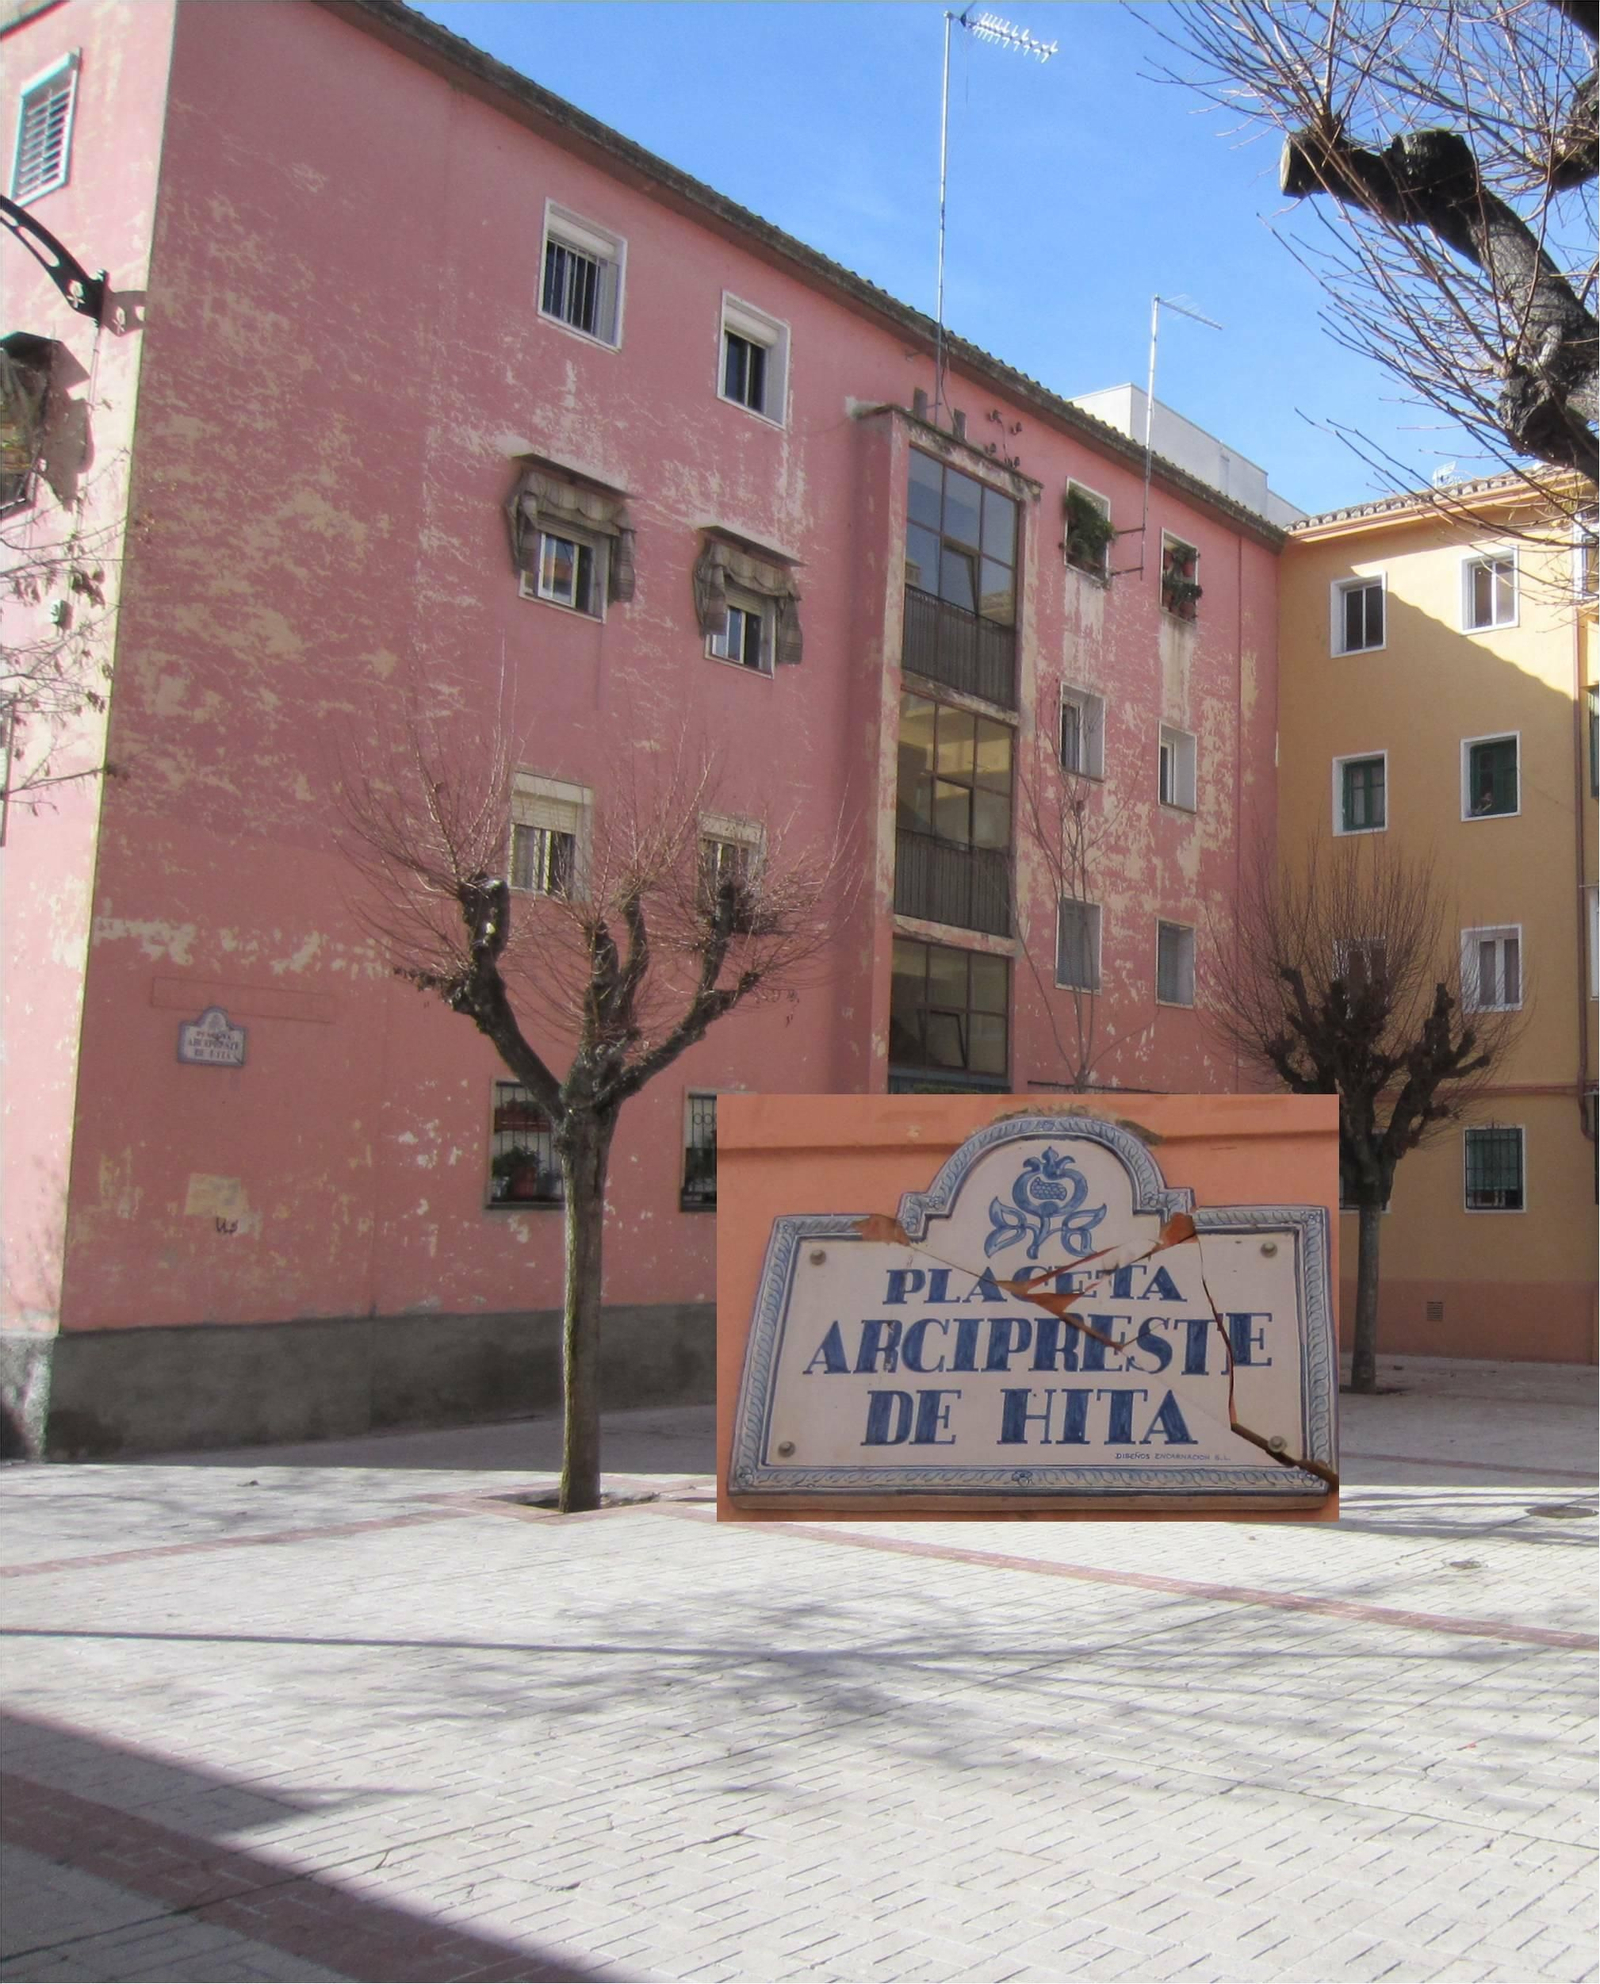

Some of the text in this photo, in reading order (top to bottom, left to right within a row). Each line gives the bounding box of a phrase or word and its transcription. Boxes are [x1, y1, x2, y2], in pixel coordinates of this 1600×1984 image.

[802, 1312, 1274, 1376] ARCIPRESTE
[860, 1388, 1199, 1446] DE HITA
